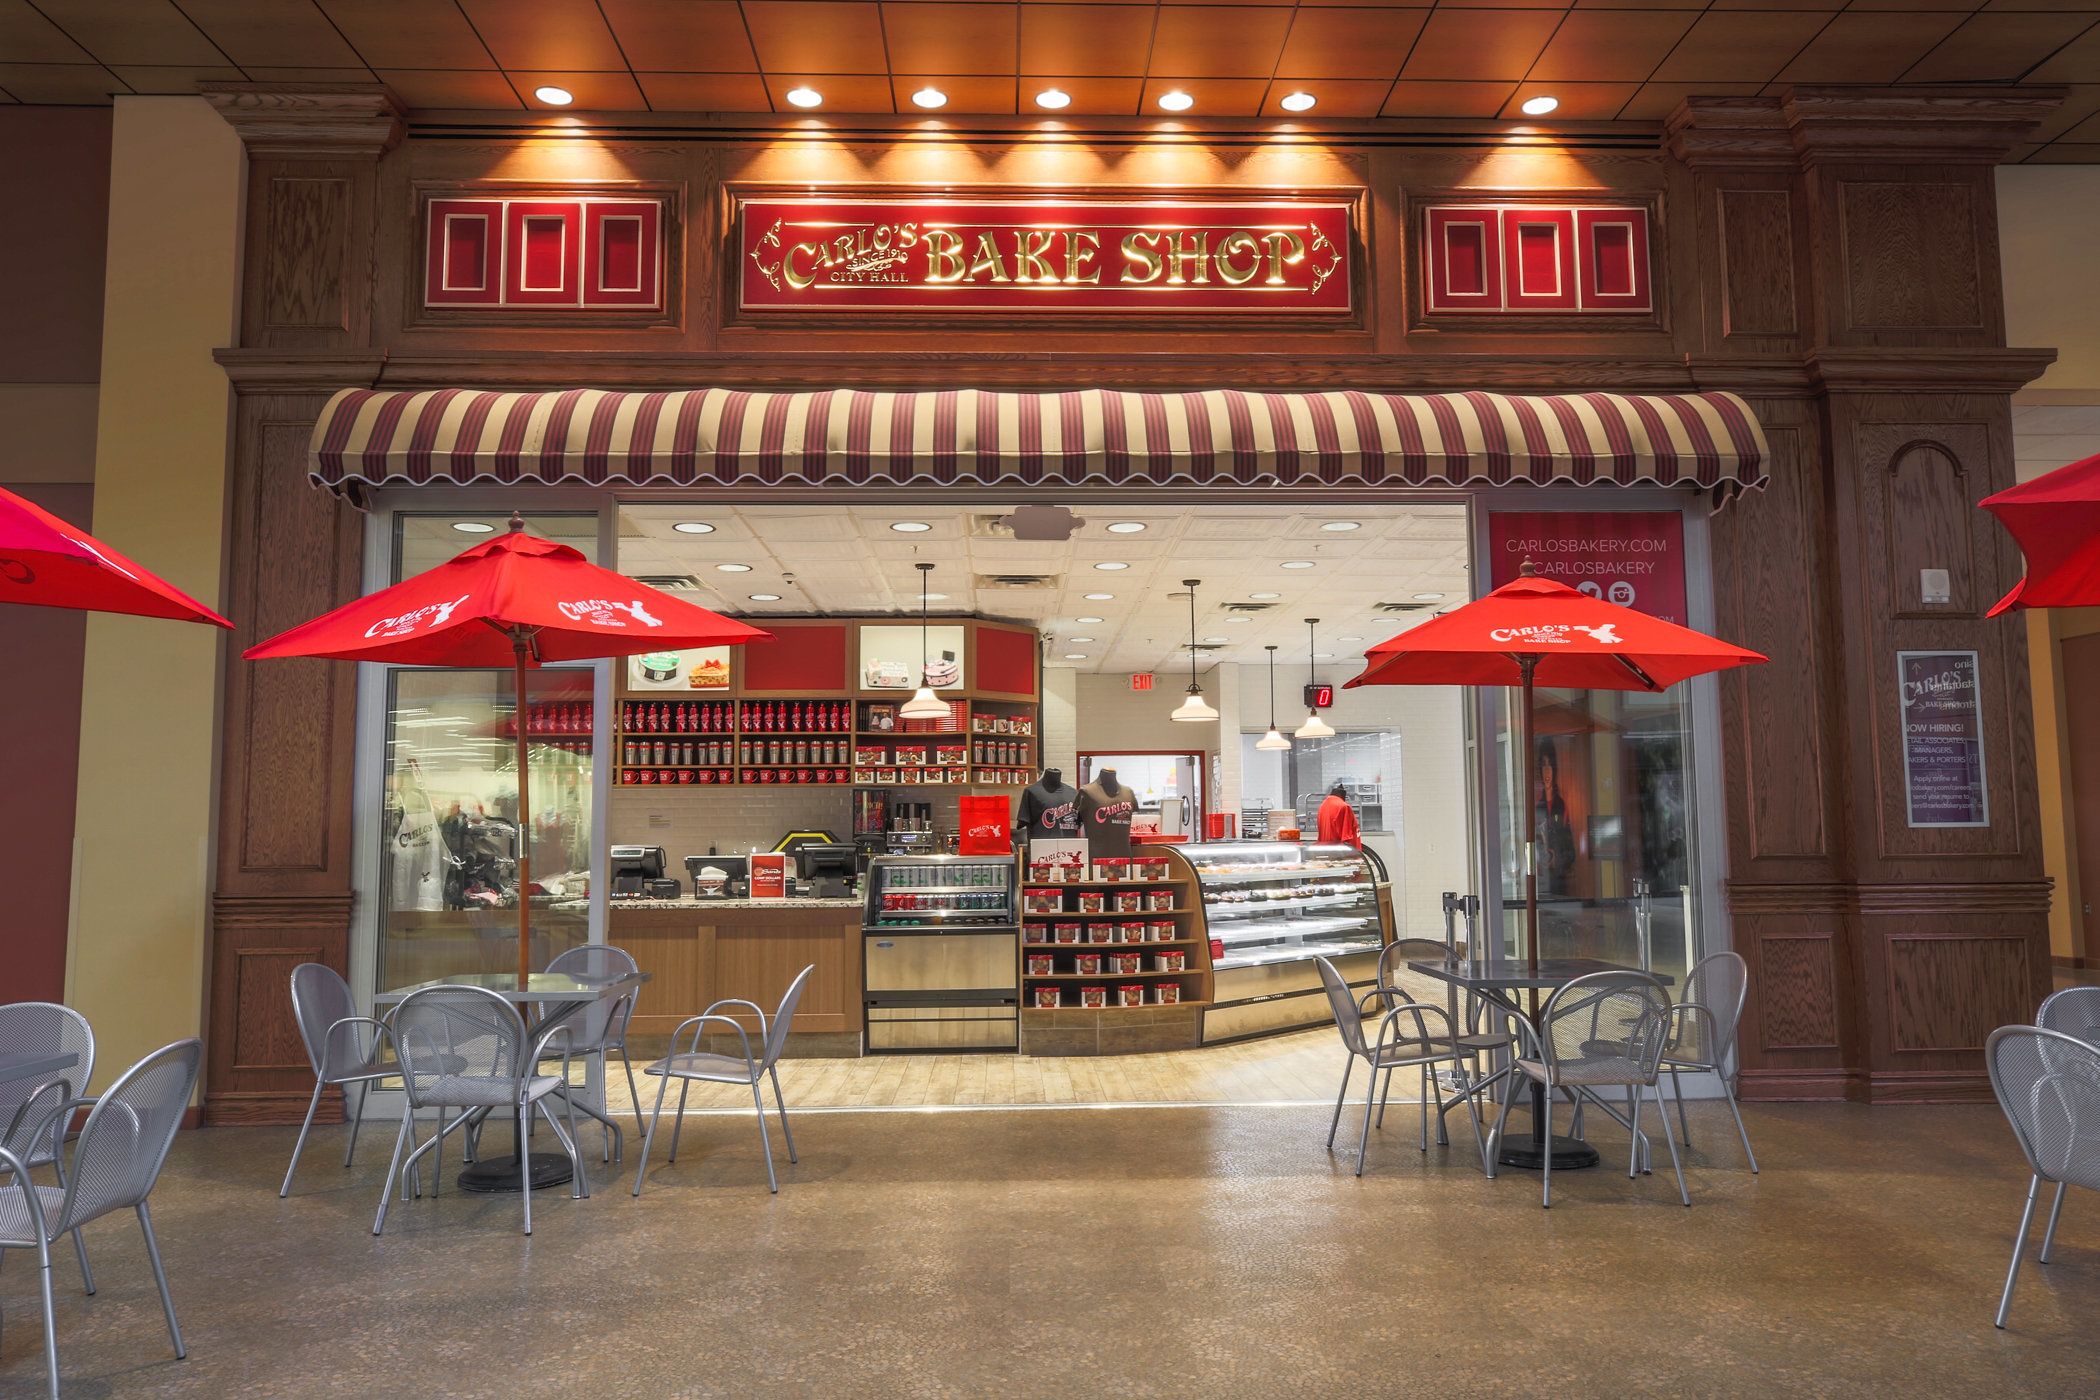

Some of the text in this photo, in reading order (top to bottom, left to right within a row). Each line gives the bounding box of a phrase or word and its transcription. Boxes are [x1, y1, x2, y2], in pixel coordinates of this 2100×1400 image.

[783, 223, 1305, 289] CARLO'S BAKE SHOP
[851, 251, 885, 266] SINCE
[830, 271, 909, 283] CITY HALL
[1506, 539, 1667, 553] CARLOSBAKERY.COM
[1490, 624, 1570, 643] CARLO'S
[1132, 673, 1153, 690] EXIT
[1319, 689, 1330, 705] 0
[1929, 723, 1964, 733] HIRING!
[1095, 801, 1133, 824] CARLO'S
